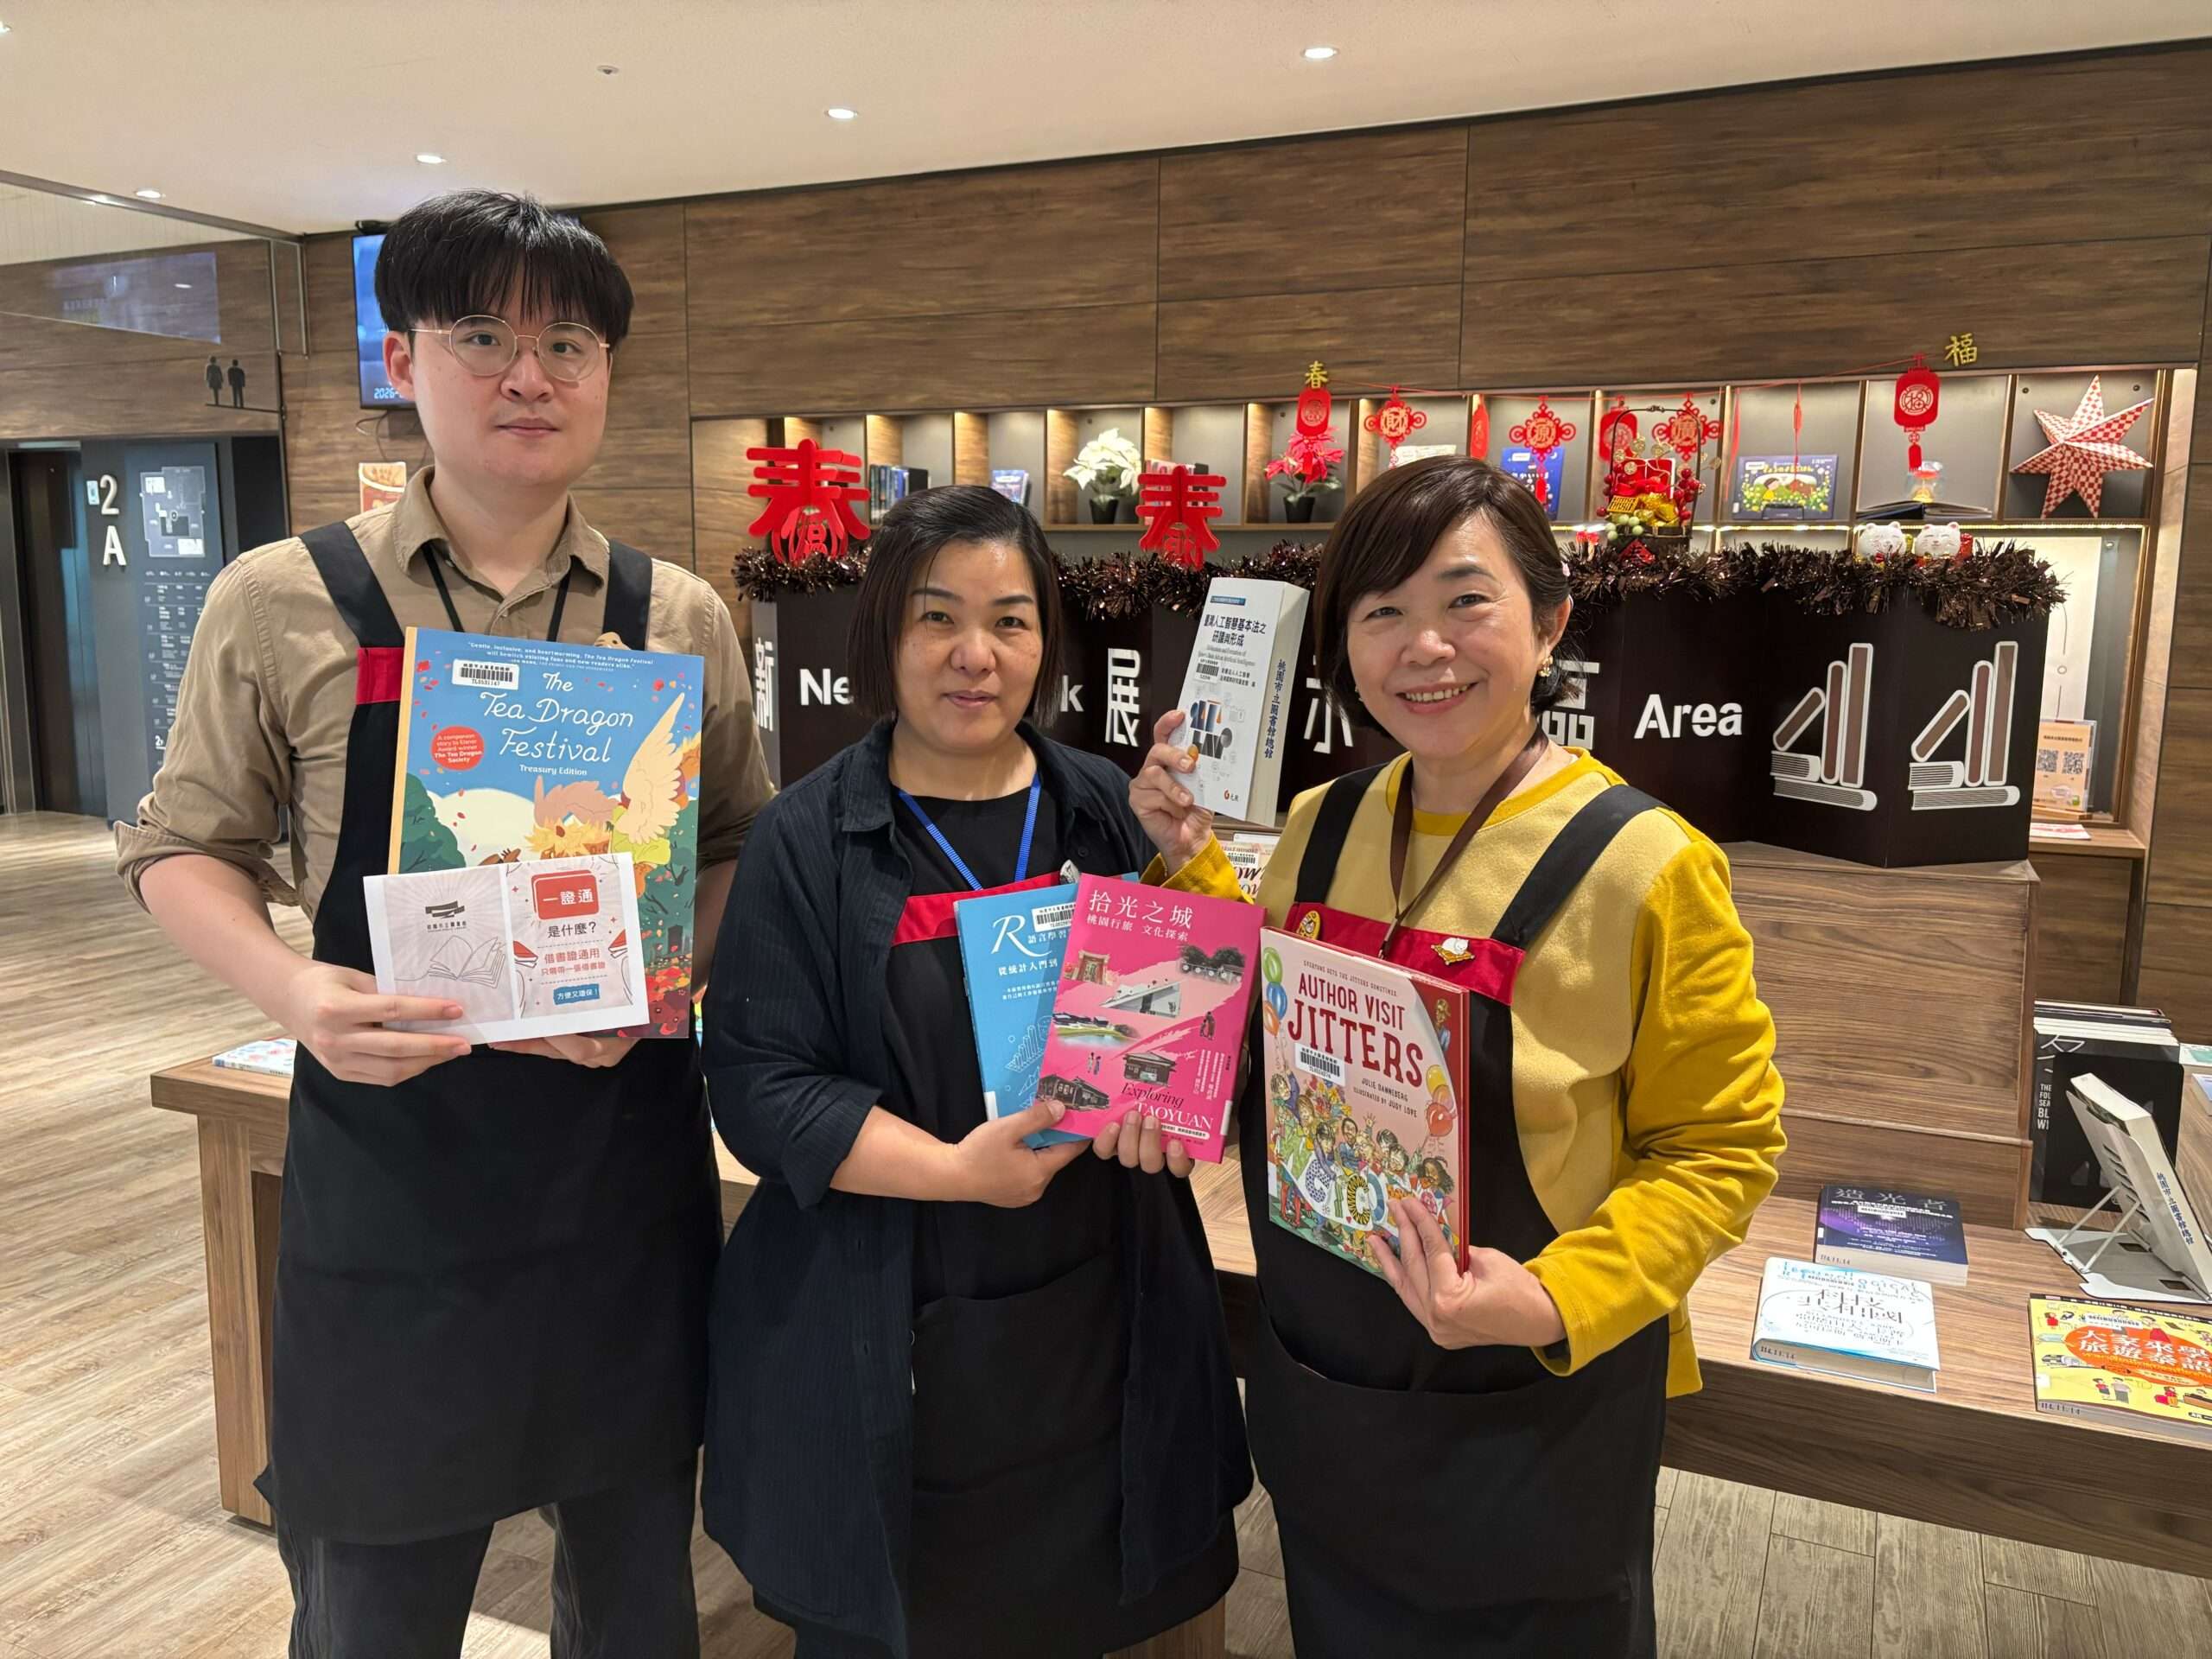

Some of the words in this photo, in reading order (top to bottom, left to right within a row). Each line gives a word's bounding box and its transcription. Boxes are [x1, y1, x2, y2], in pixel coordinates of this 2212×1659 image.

[1944, 332, 1978, 367] 福
[1305, 360, 1328, 388] 春
[99, 474, 120, 515] 2
[103, 525, 127, 566] A
[542, 671, 575, 692] The
[1105, 648, 1141, 747] 展
[1633, 693, 1743, 739] Area
[480, 690, 525, 720] Tea
[527, 697, 634, 736] Dragon
[499, 726, 612, 763] Festival
[519, 764, 557, 775] Treasury
[558, 766, 588, 777] Edition
[542, 888, 594, 906] 一證通
[1089, 890, 1193, 930] 拾光之城
[990, 914, 1053, 958] R
[1086, 913, 1134, 932] 桃園行旅
[1141, 925, 1189, 942] 文化探索
[1298, 973, 1358, 1014] AUTHOR
[1364, 995, 1406, 1031] VISIT
[1287, 999, 1424, 1088] JITTERS
[1121, 1082, 1185, 1110] Exploring
[1134, 1101, 1214, 1130] TAOYUAN
